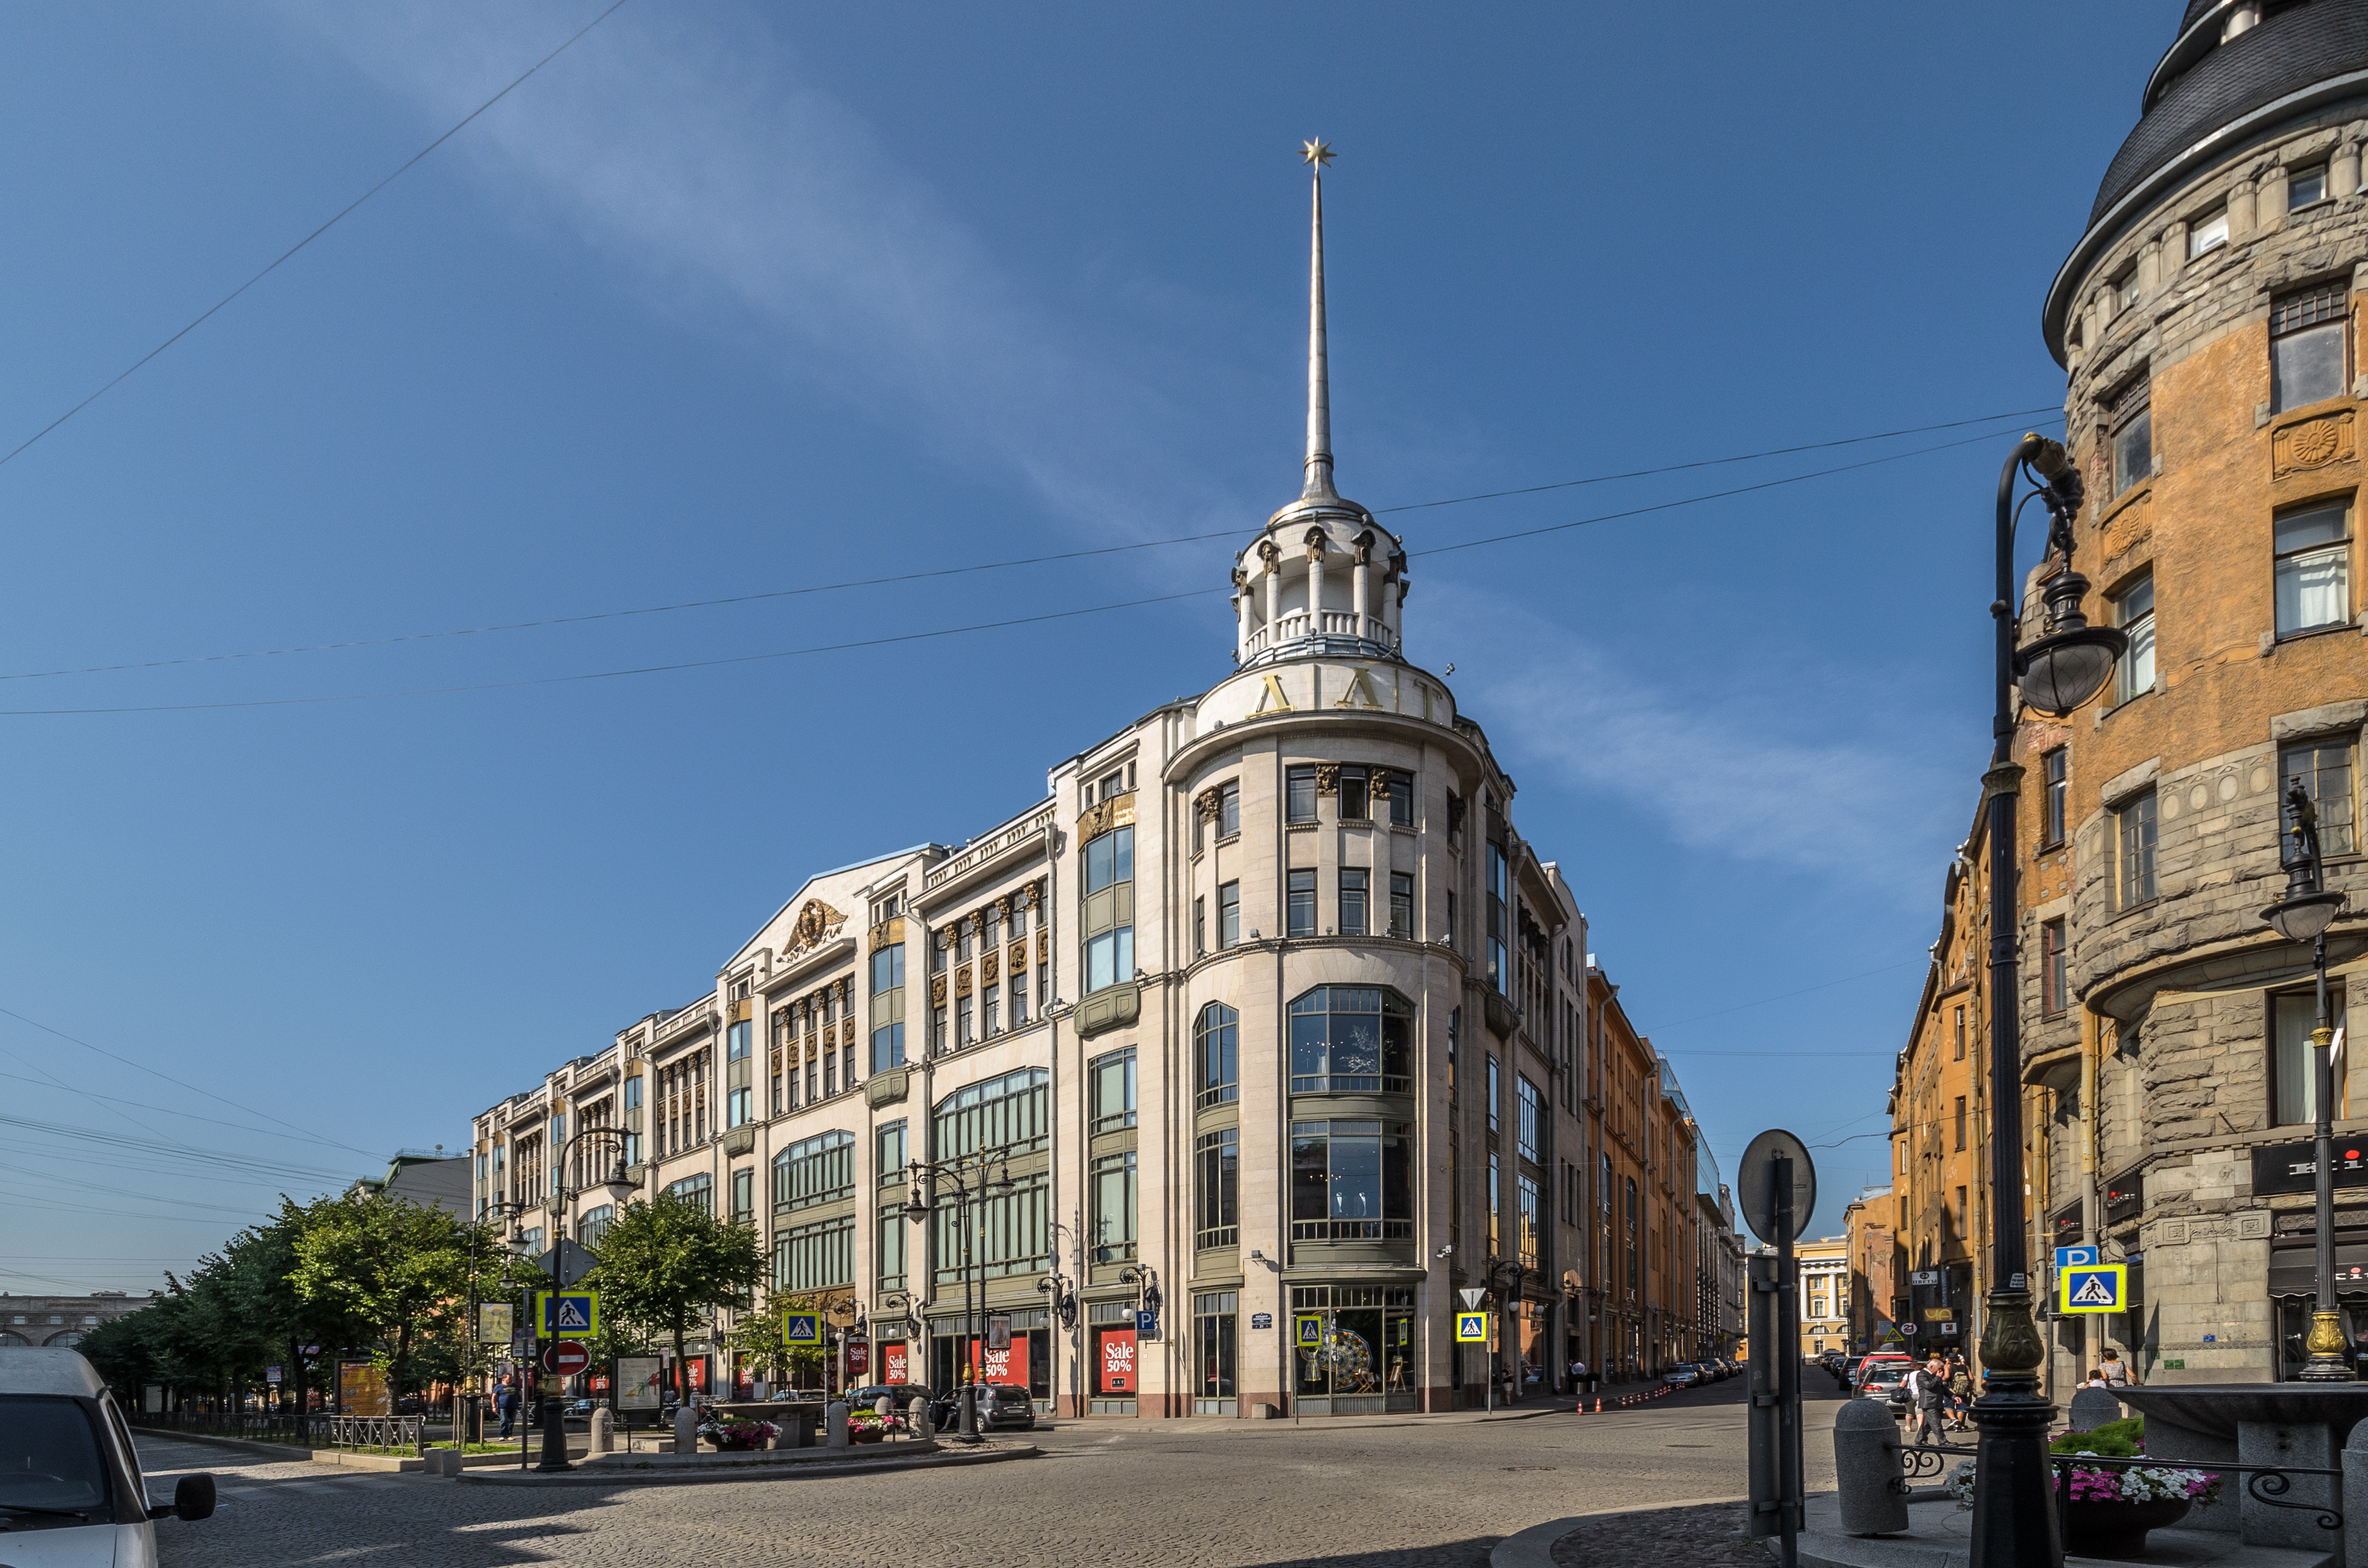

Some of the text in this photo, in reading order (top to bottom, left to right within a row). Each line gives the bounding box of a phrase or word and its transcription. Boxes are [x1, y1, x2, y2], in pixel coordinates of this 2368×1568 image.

[1141, 1313, 1152, 1328] P
[850, 1347, 867, 1355] Sale
[984, 1347, 1010, 1363] Sale
[1105, 1341, 1134, 1359] Sale
[888, 1355, 907, 1369] Sale
[1106, 1359, 1132, 1372] 50%
[688, 1365, 698, 1377] ale
[889, 1369, 905, 1379] 50%
[985, 1363, 1008, 1376] 50%
